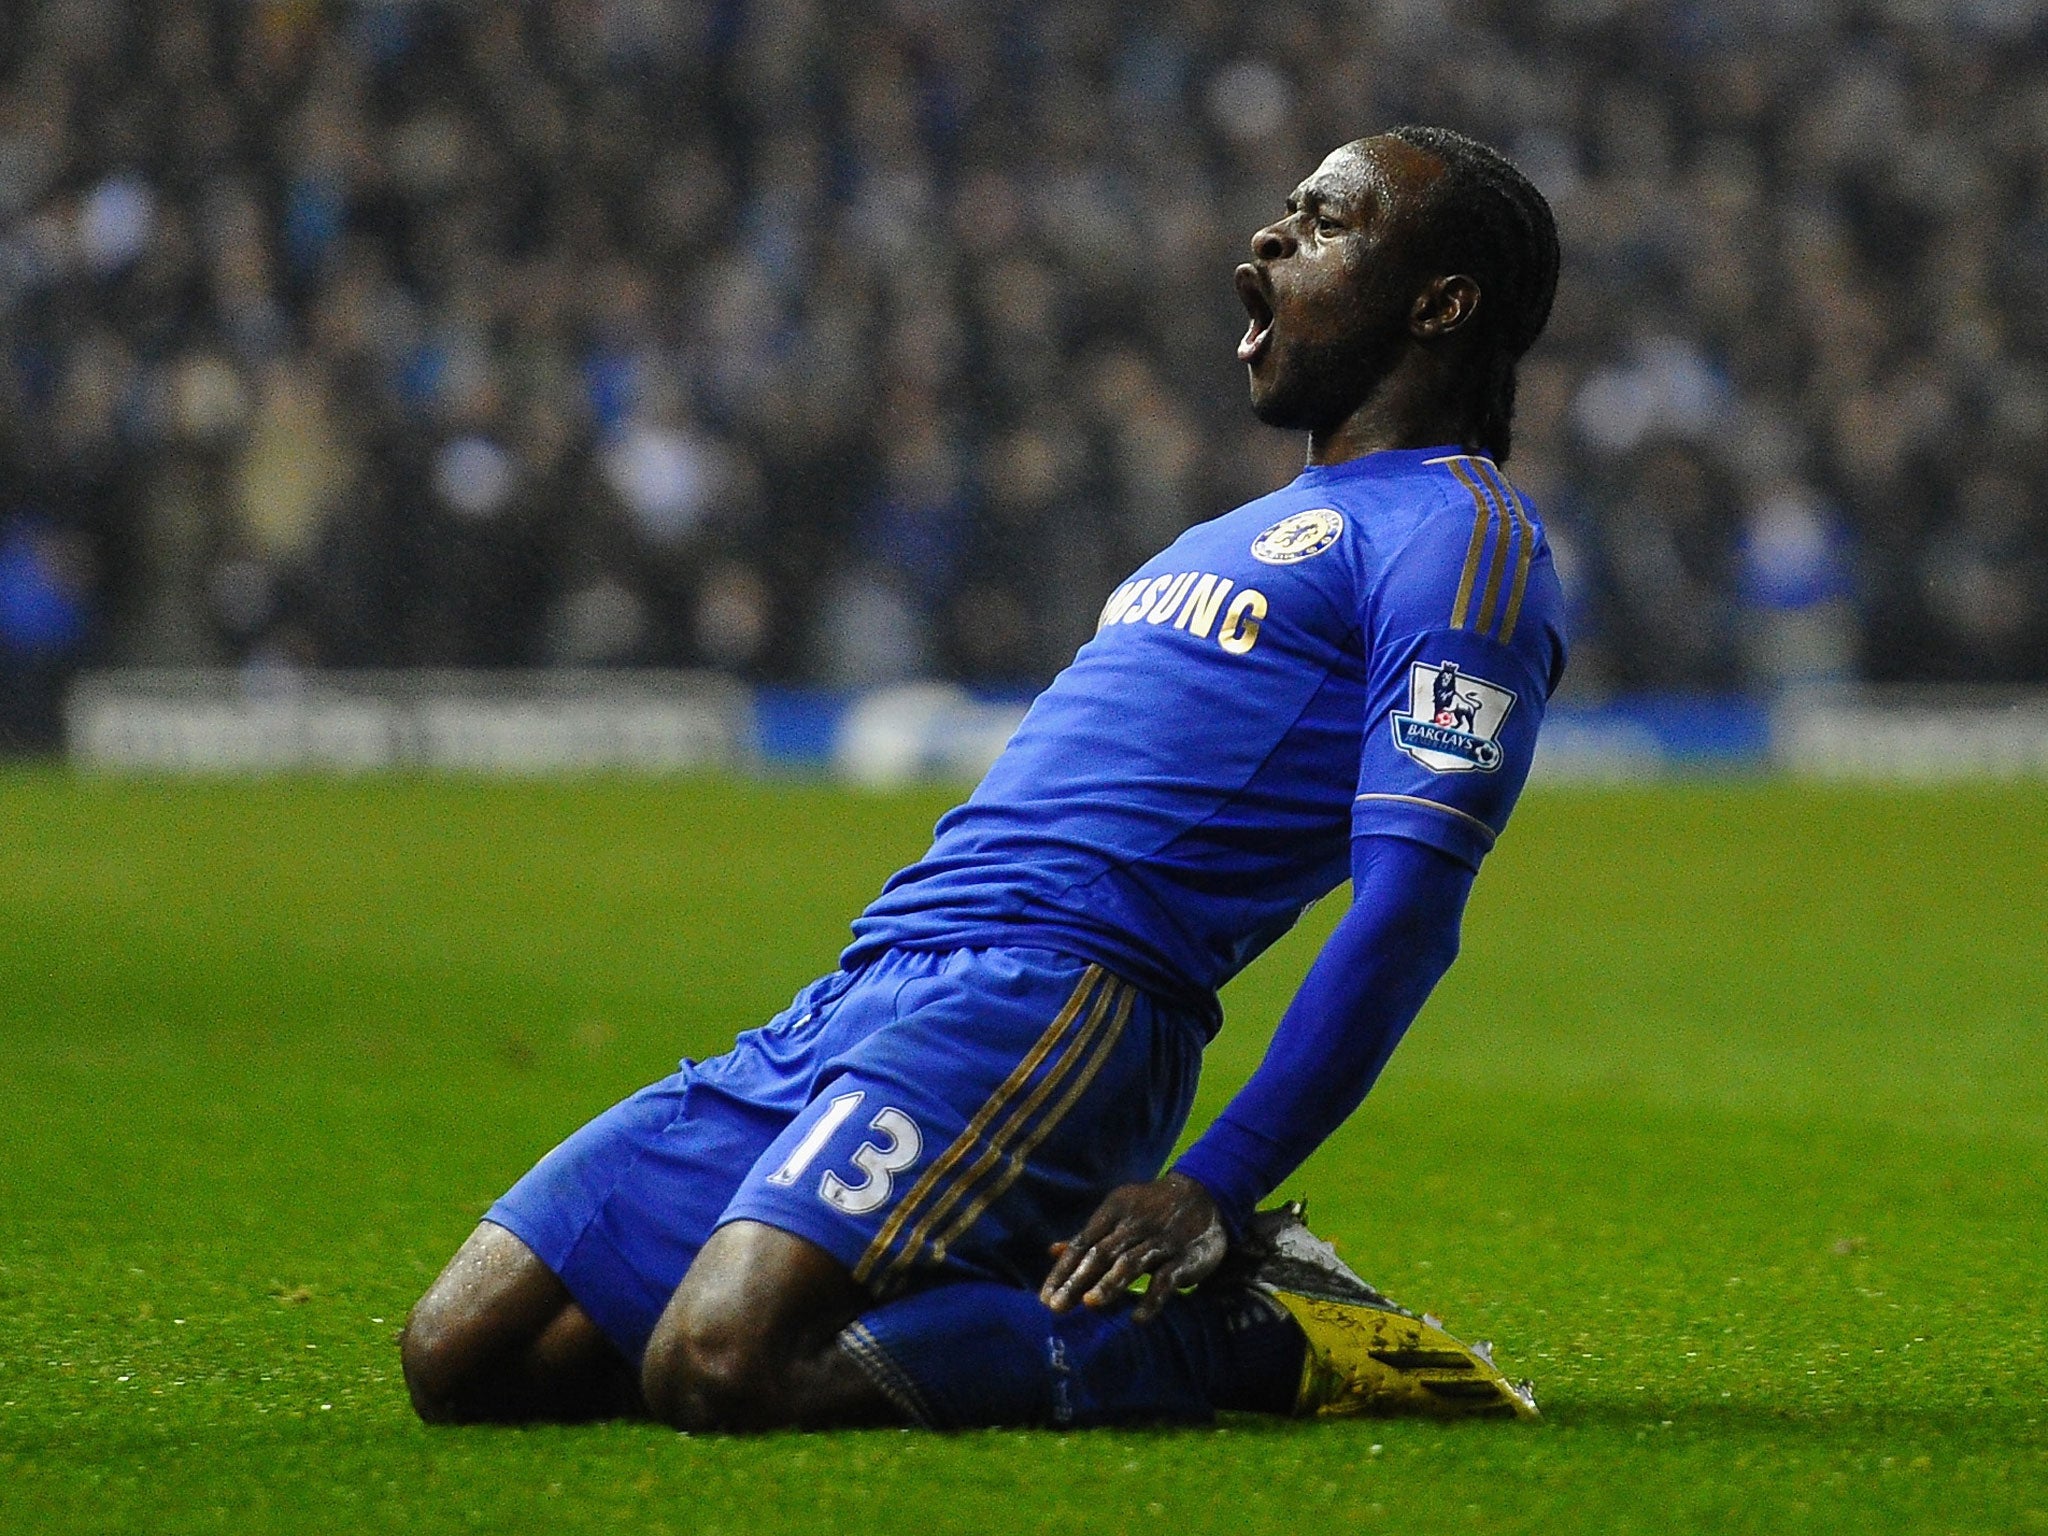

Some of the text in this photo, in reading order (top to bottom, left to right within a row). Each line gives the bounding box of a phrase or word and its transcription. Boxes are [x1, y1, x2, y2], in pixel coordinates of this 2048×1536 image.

[1099, 571, 1268, 655] MSUNG
[1407, 724, 1473, 750] BARCLAYS
[767, 1091, 923, 1214] 13
